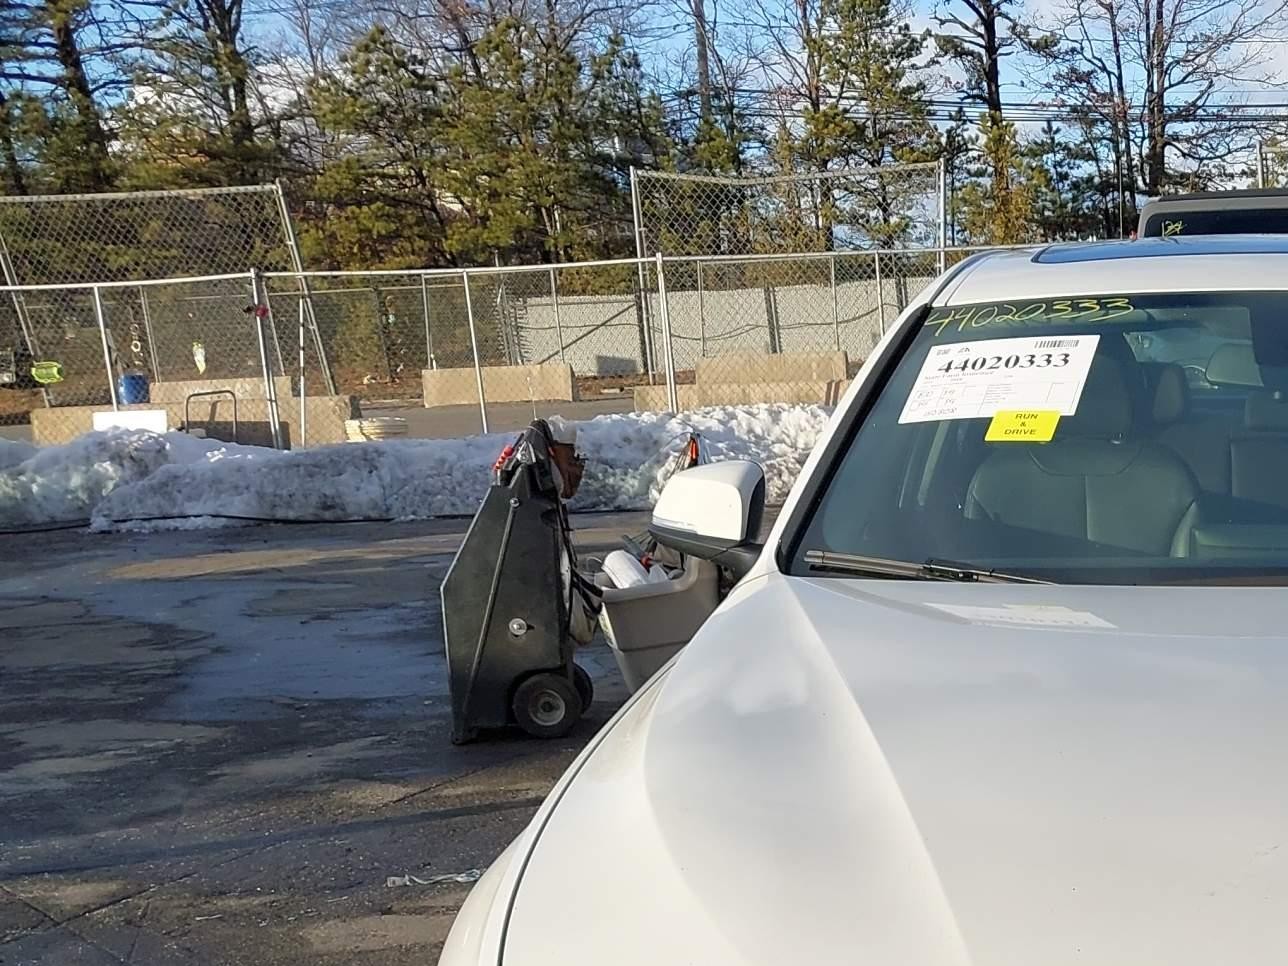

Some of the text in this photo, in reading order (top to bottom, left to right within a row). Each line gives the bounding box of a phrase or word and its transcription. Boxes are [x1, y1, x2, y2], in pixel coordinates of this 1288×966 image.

[925, 298, 1134, 337] 44020333
[937, 352, 1071, 374] 44020333
[1015, 412, 1039, 420] RUN
[1004, 428, 1037, 436] DRIVE
